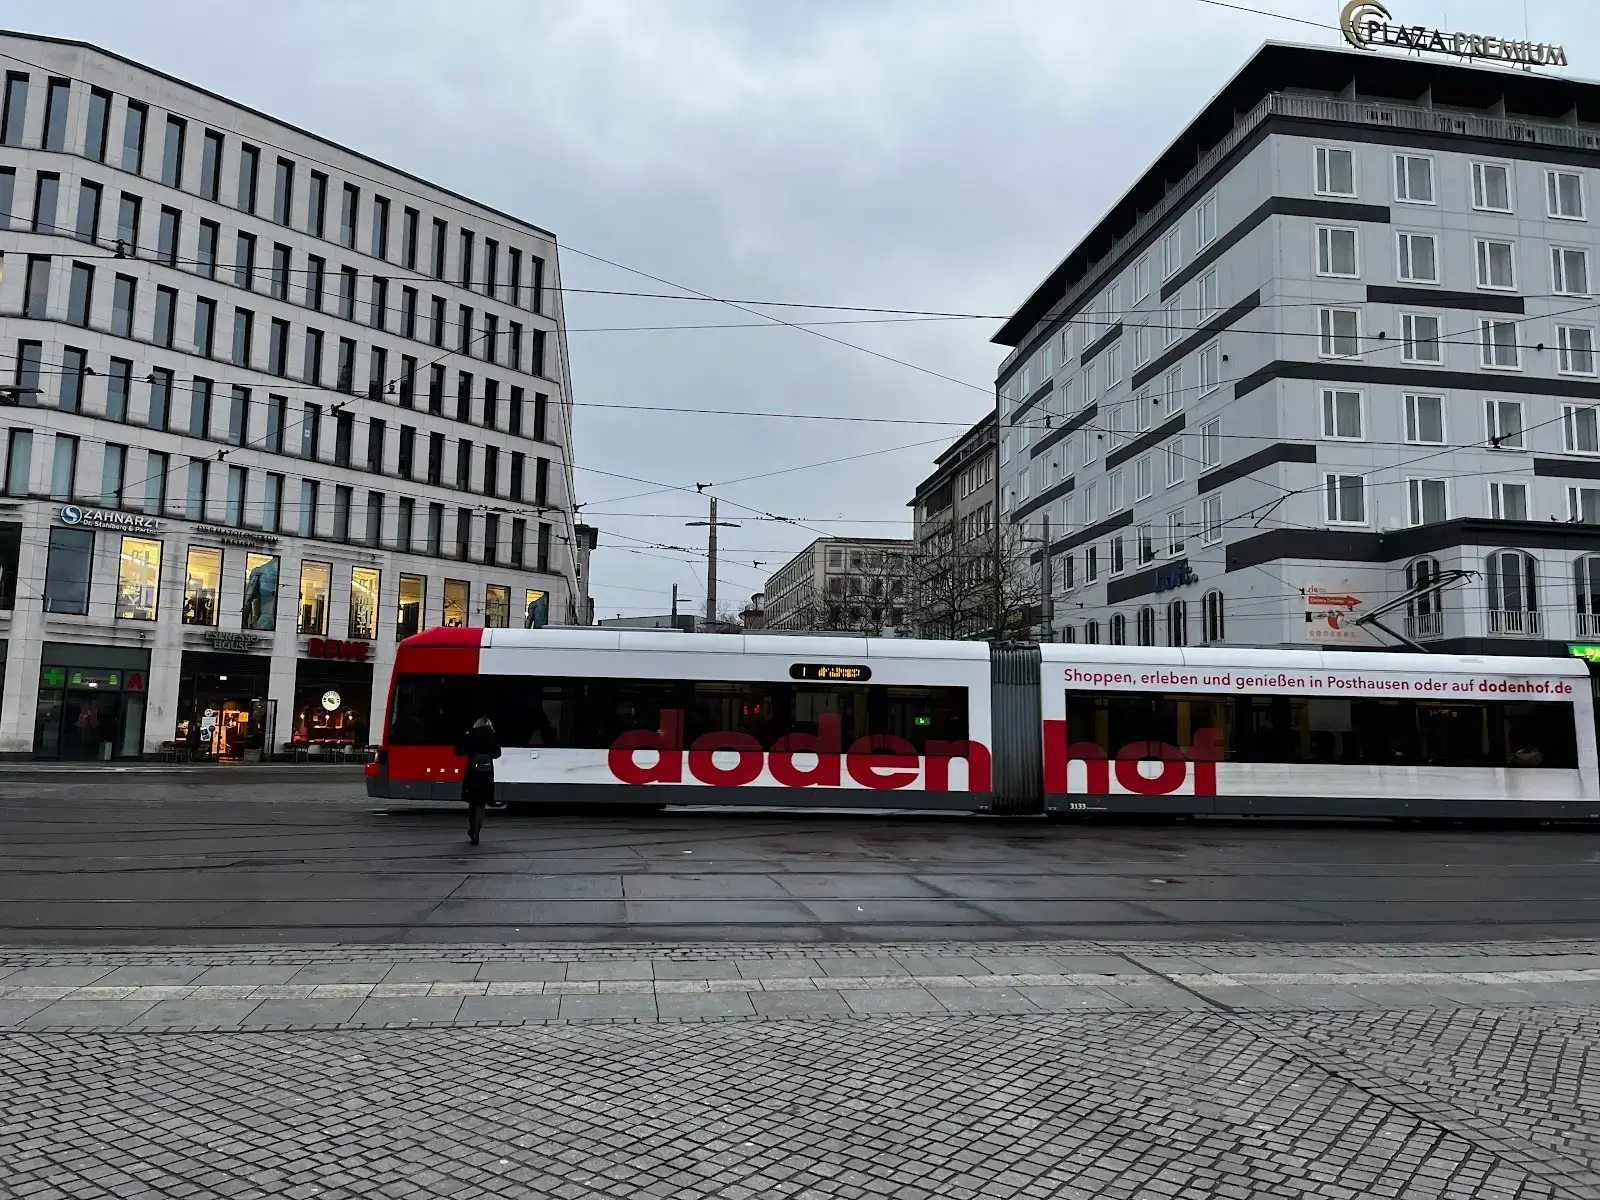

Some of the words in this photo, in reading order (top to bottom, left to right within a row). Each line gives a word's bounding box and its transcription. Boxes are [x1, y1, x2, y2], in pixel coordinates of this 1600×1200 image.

[1367, 20, 1447, 52] PLAZA
[1453, 31, 1568, 67] PREMIUM
[83, 509, 159, 528] ZAHNARZT
[94, 520, 127, 532] Stahlberg
[204, 631, 260, 642] ESPRESSO
[212, 640, 252, 651] HOUSE
[308, 638, 370, 661] REWE
[1063, 669, 1136, 686] Shoppen,
[1141, 671, 1198, 685] erleben
[1203, 673, 1231, 686] und
[1236, 674, 1305, 690] genießen
[1310, 676, 1322, 688] in
[1327, 676, 1409, 690] Posthausen
[1414, 680, 1448, 691] oder
[1452, 680, 1475, 692] auf
[1479, 681, 1573, 694] dodenhof.de
[607, 708, 992, 792] doden
[1044, 719, 1225, 796] hof
[1069, 802, 1086, 810] 3133
